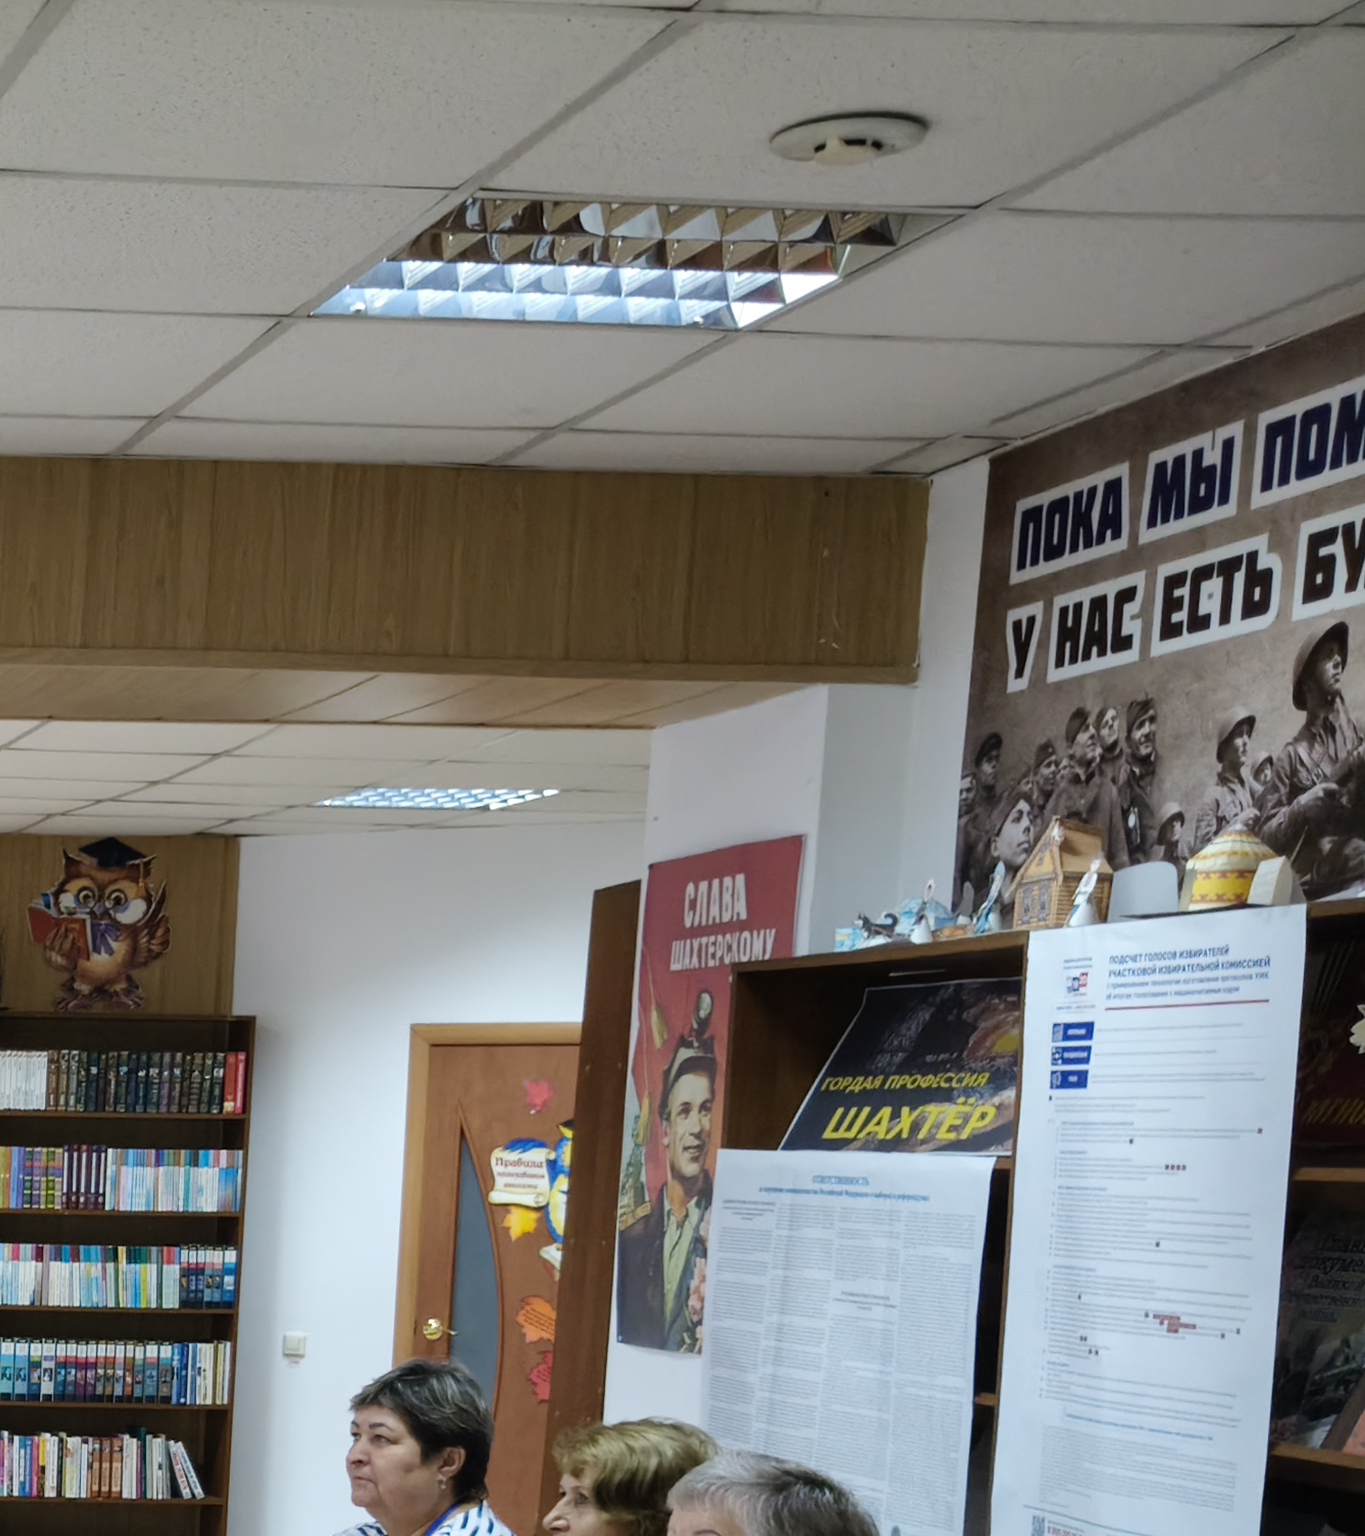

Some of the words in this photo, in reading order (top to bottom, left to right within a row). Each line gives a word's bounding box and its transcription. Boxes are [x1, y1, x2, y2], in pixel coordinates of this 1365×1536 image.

[1017, 476, 1123, 572] ПОКА
[1147, 435, 1235, 531] МЫ
[1260, 389, 1365, 493] ПОМ
[1012, 614, 1037, 681] У
[1054, 585, 1138, 669] НАС
[1159, 549, 1274, 642] ЕСТЬ
[683, 873, 748, 929] СЛАВА
[670, 928, 777, 972] ШАХТЕРСКОМУ
[821, 1075, 881, 1094] ГОРДАЯ
[884, 1072, 990, 1090] ПРОФЕССИЯ
[822, 1096, 998, 1141] ШАХТЁР
